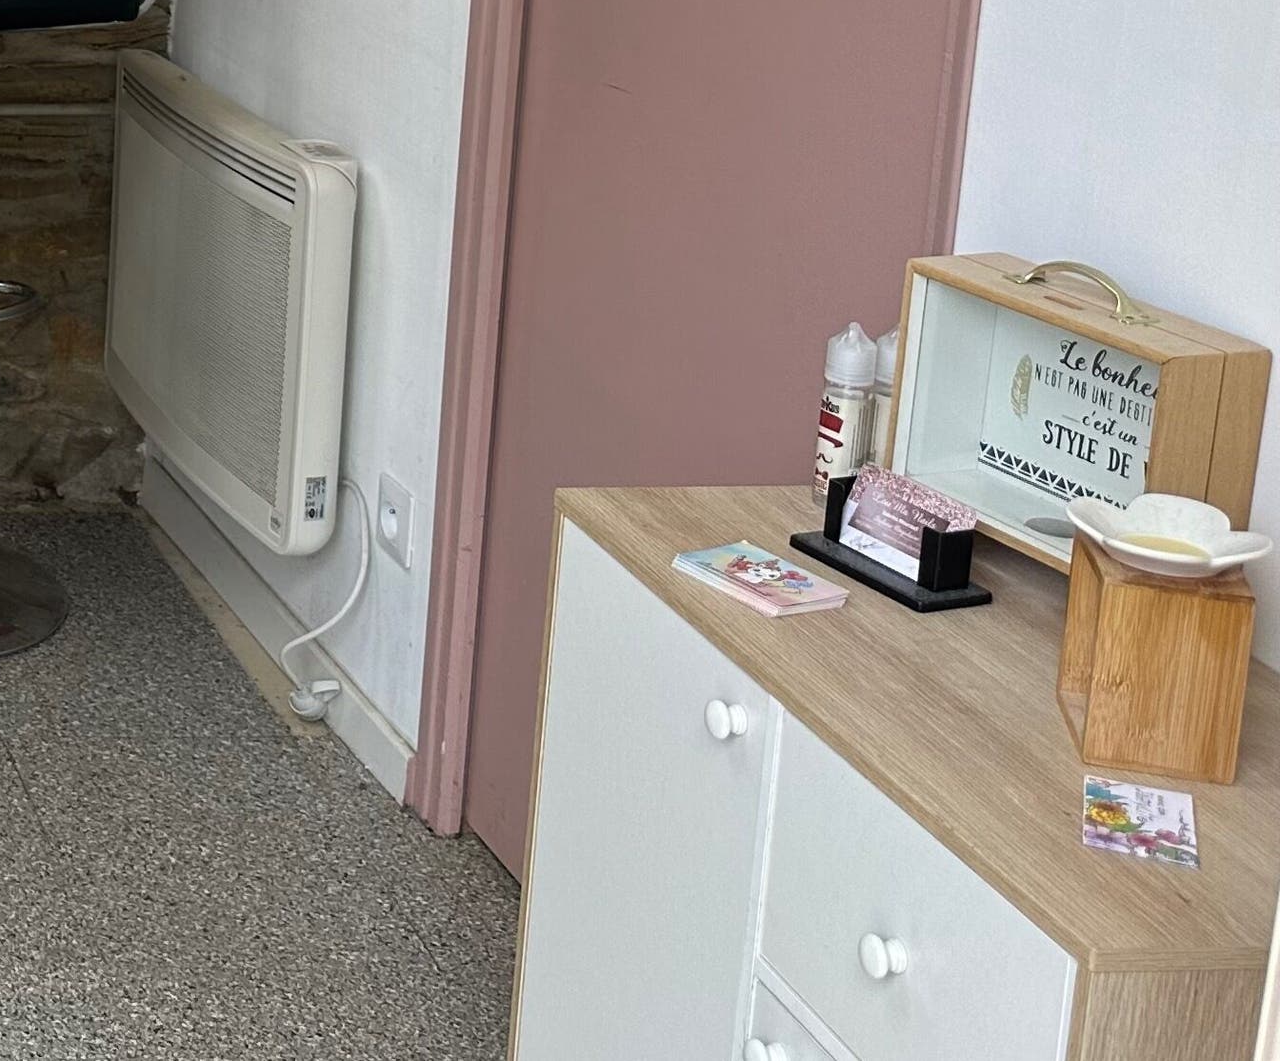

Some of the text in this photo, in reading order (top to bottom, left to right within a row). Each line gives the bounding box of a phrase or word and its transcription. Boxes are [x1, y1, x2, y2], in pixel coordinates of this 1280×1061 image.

[1060, 339, 1089, 371] Le
[1068, 375, 1087, 400] PAS
[1091, 387, 1115, 412] UNE
[1081, 410, 1139, 446] c'est un
[1042, 419, 1133, 480] STYLE DE
